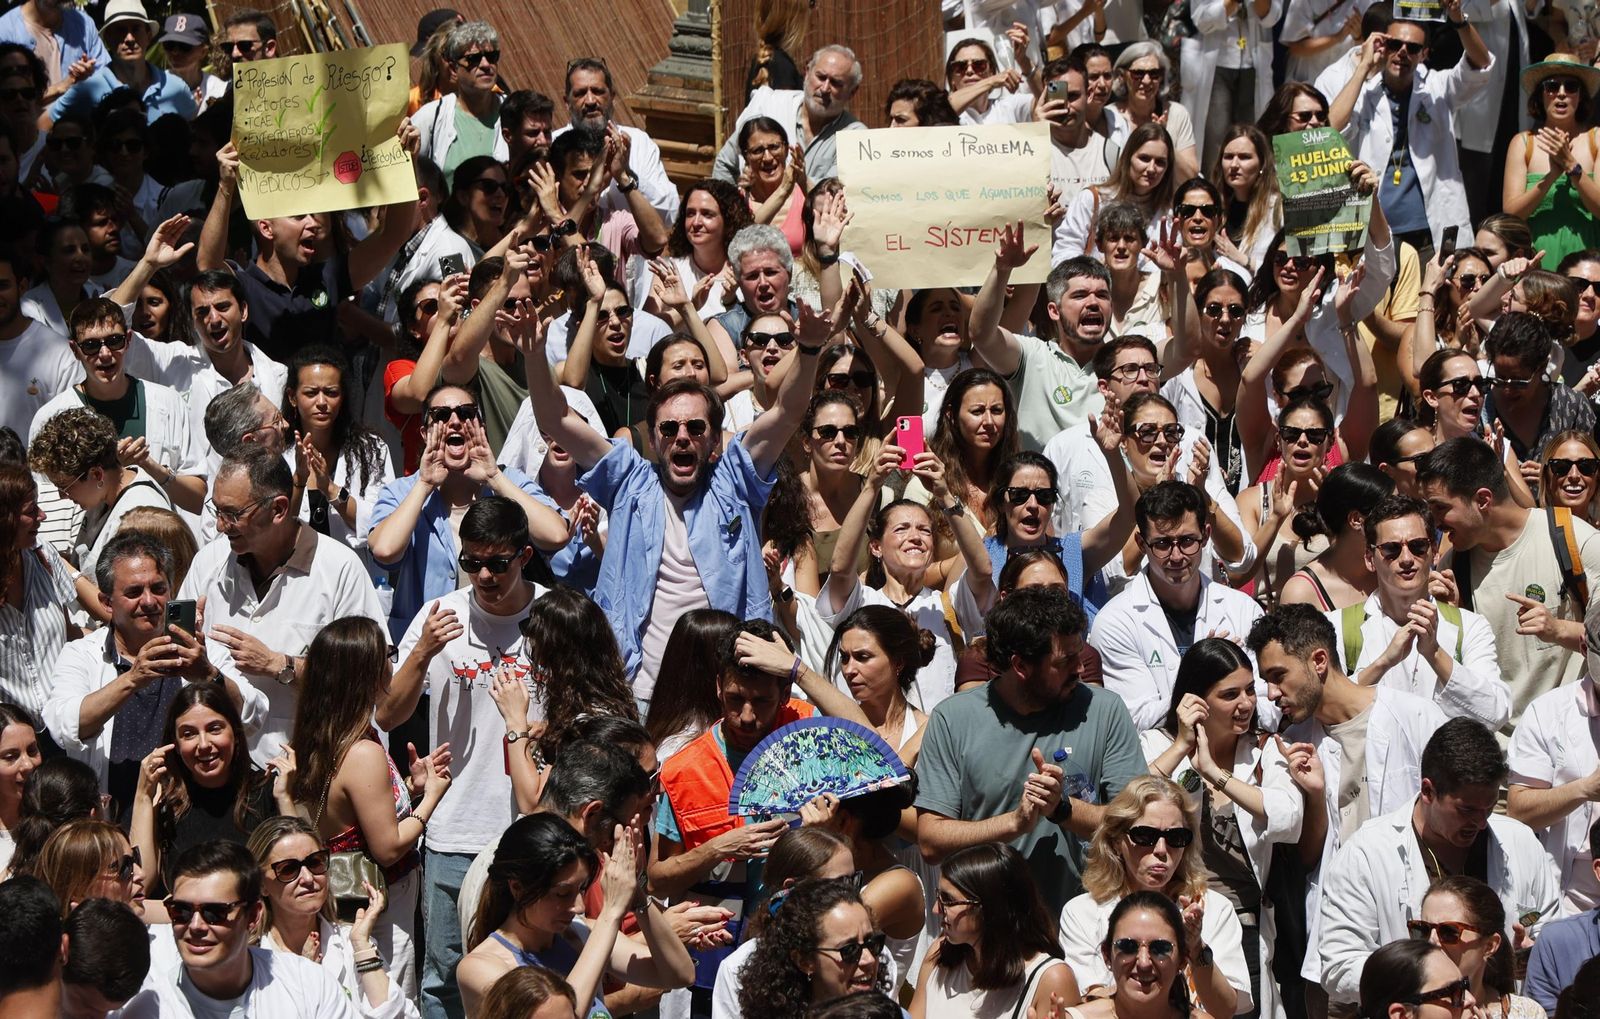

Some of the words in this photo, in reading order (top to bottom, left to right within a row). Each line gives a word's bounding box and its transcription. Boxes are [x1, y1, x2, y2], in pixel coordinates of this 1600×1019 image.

[174, 15, 187, 32] B
[302, 64, 315, 85] de
[859, 138, 882, 161] No
[1290, 147, 1351, 168] HUELGA
[1290, 170, 1308, 183] 13
[1311, 160, 1354, 179] JUNIO
[916, 191, 939, 201] LOS
[945, 189, 971, 202] QUE
[886, 234, 911, 251] EL
